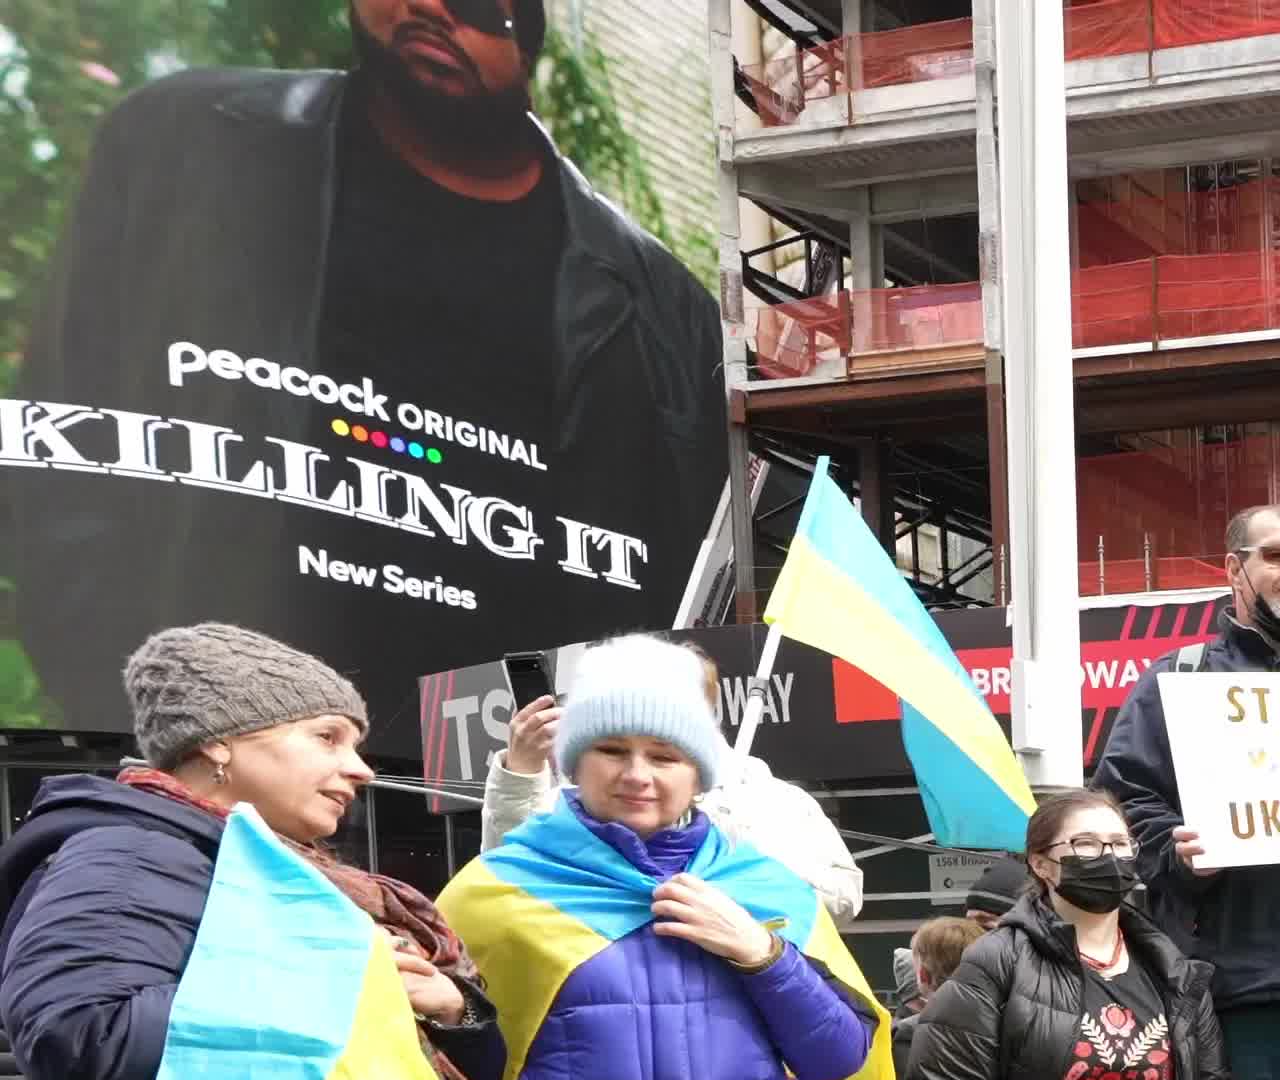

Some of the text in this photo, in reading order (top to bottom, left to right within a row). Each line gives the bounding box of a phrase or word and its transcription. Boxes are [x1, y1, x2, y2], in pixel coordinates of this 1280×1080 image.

[168, 341, 548, 471] peacock ORIGINAL
[0, 397, 648, 590] KILLING IT
[298, 544, 477, 610] New Series
[442, 687, 515, 781] TS
